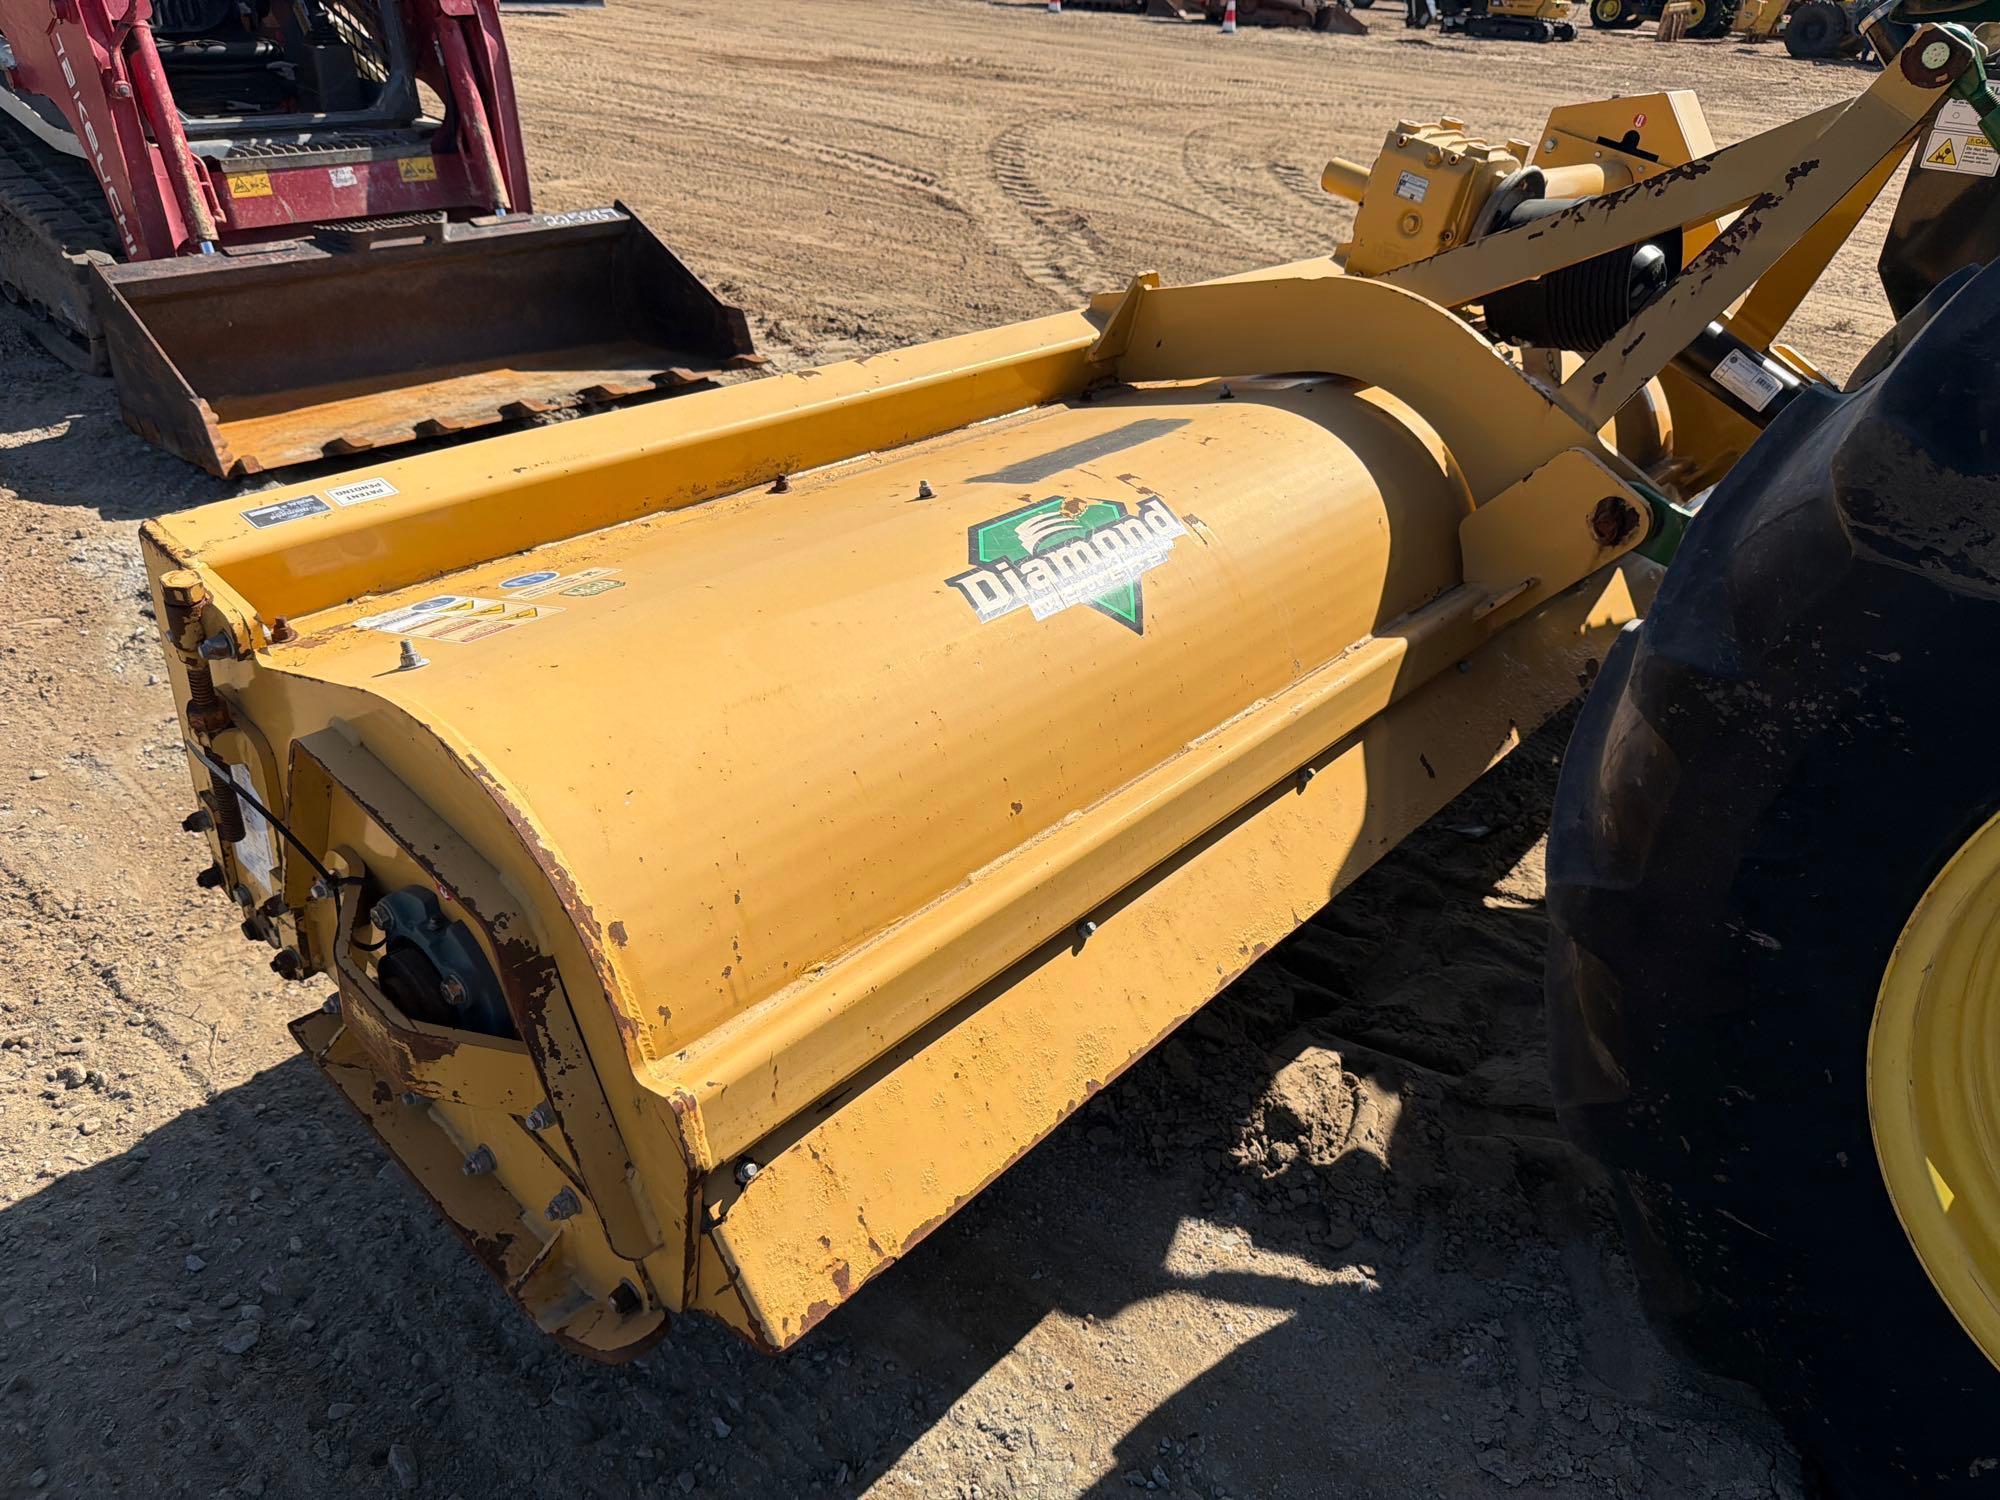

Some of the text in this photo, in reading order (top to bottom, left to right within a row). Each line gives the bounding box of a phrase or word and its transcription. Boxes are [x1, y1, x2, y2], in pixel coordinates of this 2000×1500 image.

[335, 482, 382, 497] PENDING
[346, 488, 384, 501] PATENT
[954, 499, 1188, 616] Diamond
